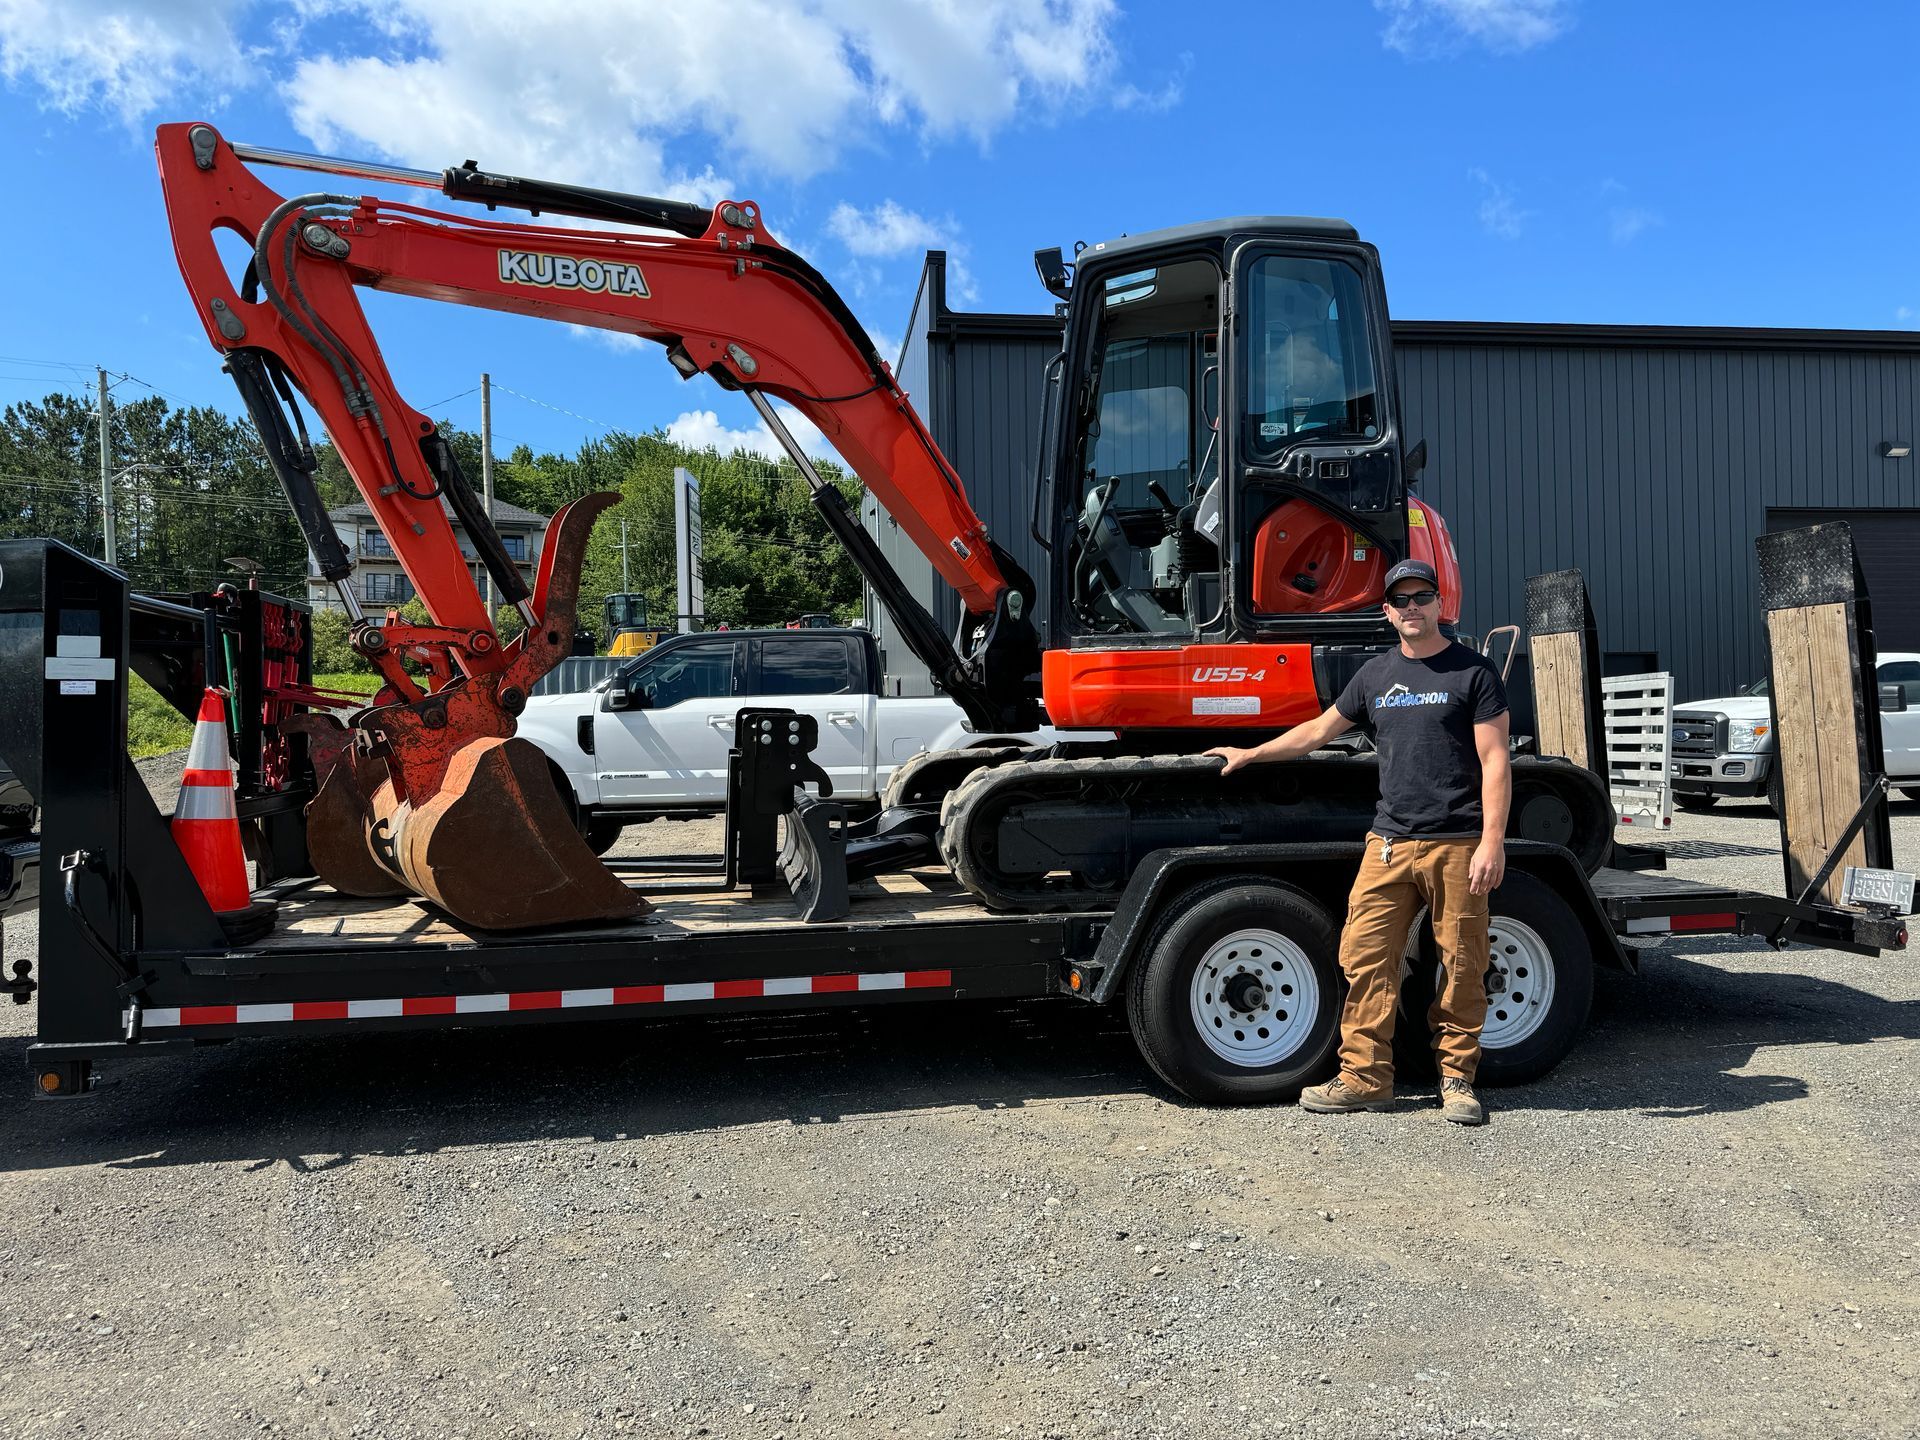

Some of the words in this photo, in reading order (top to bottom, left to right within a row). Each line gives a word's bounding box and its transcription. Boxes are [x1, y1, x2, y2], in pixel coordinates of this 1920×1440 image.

[499, 250, 650, 297] KUBOTA
[1192, 667, 1266, 682] U55-4
[1375, 691, 1449, 709] EXCAVACHON
